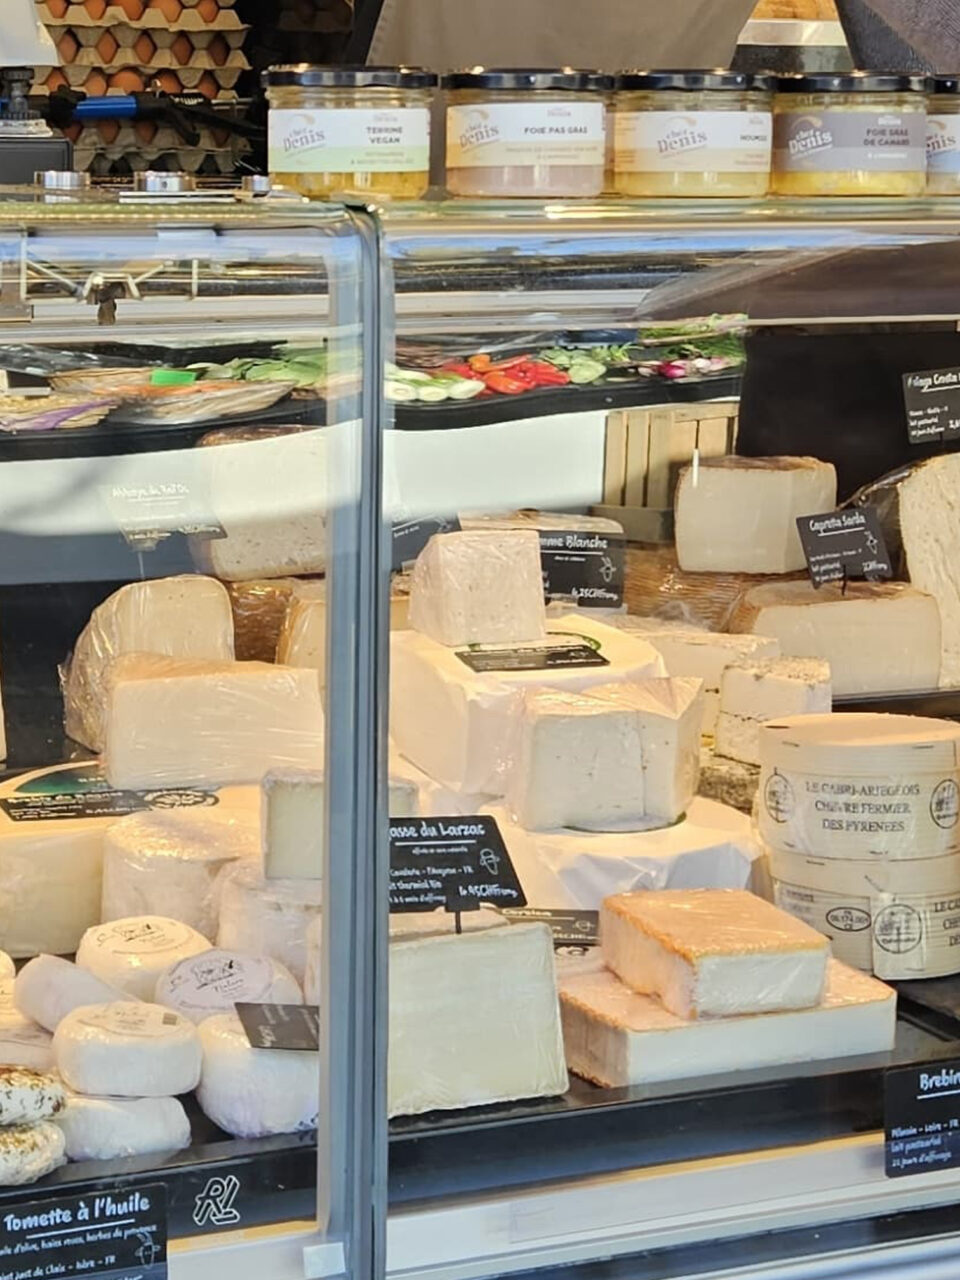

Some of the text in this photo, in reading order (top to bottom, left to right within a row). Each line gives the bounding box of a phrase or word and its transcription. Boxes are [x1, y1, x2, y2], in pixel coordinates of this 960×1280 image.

[283, 129, 326, 152] Denis
[369, 136, 400, 144] VEGAN
[459, 124, 500, 148] Denis
[656, 131, 708, 153] Denis
[788, 130, 833, 154] Denis
[565, 534, 608, 549] Blanche
[420, 821, 436, 837] du
[438, 822, 486, 837] Larzac
[822, 819, 844, 831] DES
[4, 1191, 151, 1232] Tomette à l'huile
[105, 1256, 116, 1266] FR
